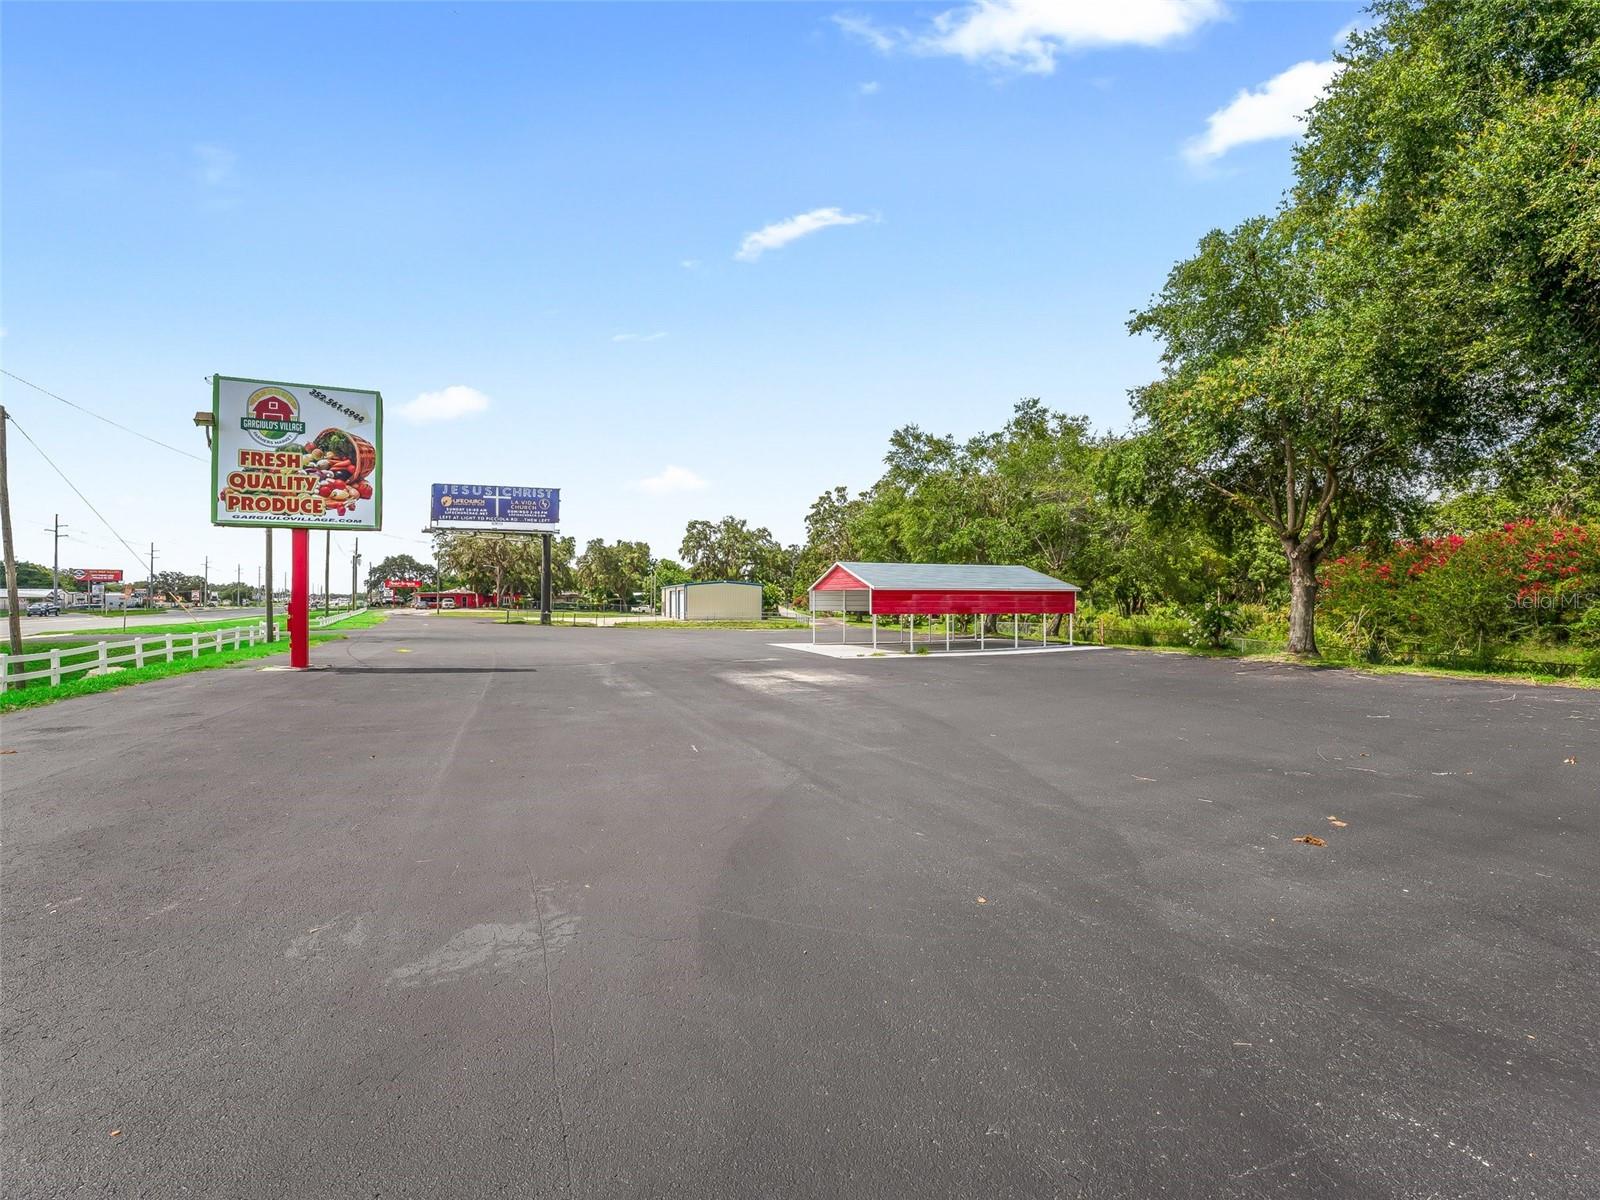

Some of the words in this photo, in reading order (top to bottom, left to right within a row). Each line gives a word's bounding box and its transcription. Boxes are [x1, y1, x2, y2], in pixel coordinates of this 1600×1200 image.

[243, 419, 279, 430] GARGIULO'S
[280, 422, 304, 432] VILLAGE
[274, 434, 293, 445] MARKET
[240, 451, 301, 468] FRESH
[229, 473, 318, 492] QUALITY
[442, 484, 494, 497] JESUS
[502, 487, 553, 499] CHRIST
[227, 496, 324, 514] PRODUCE
[232, 514, 362, 524] GARGIULOVILLAGE.COM
